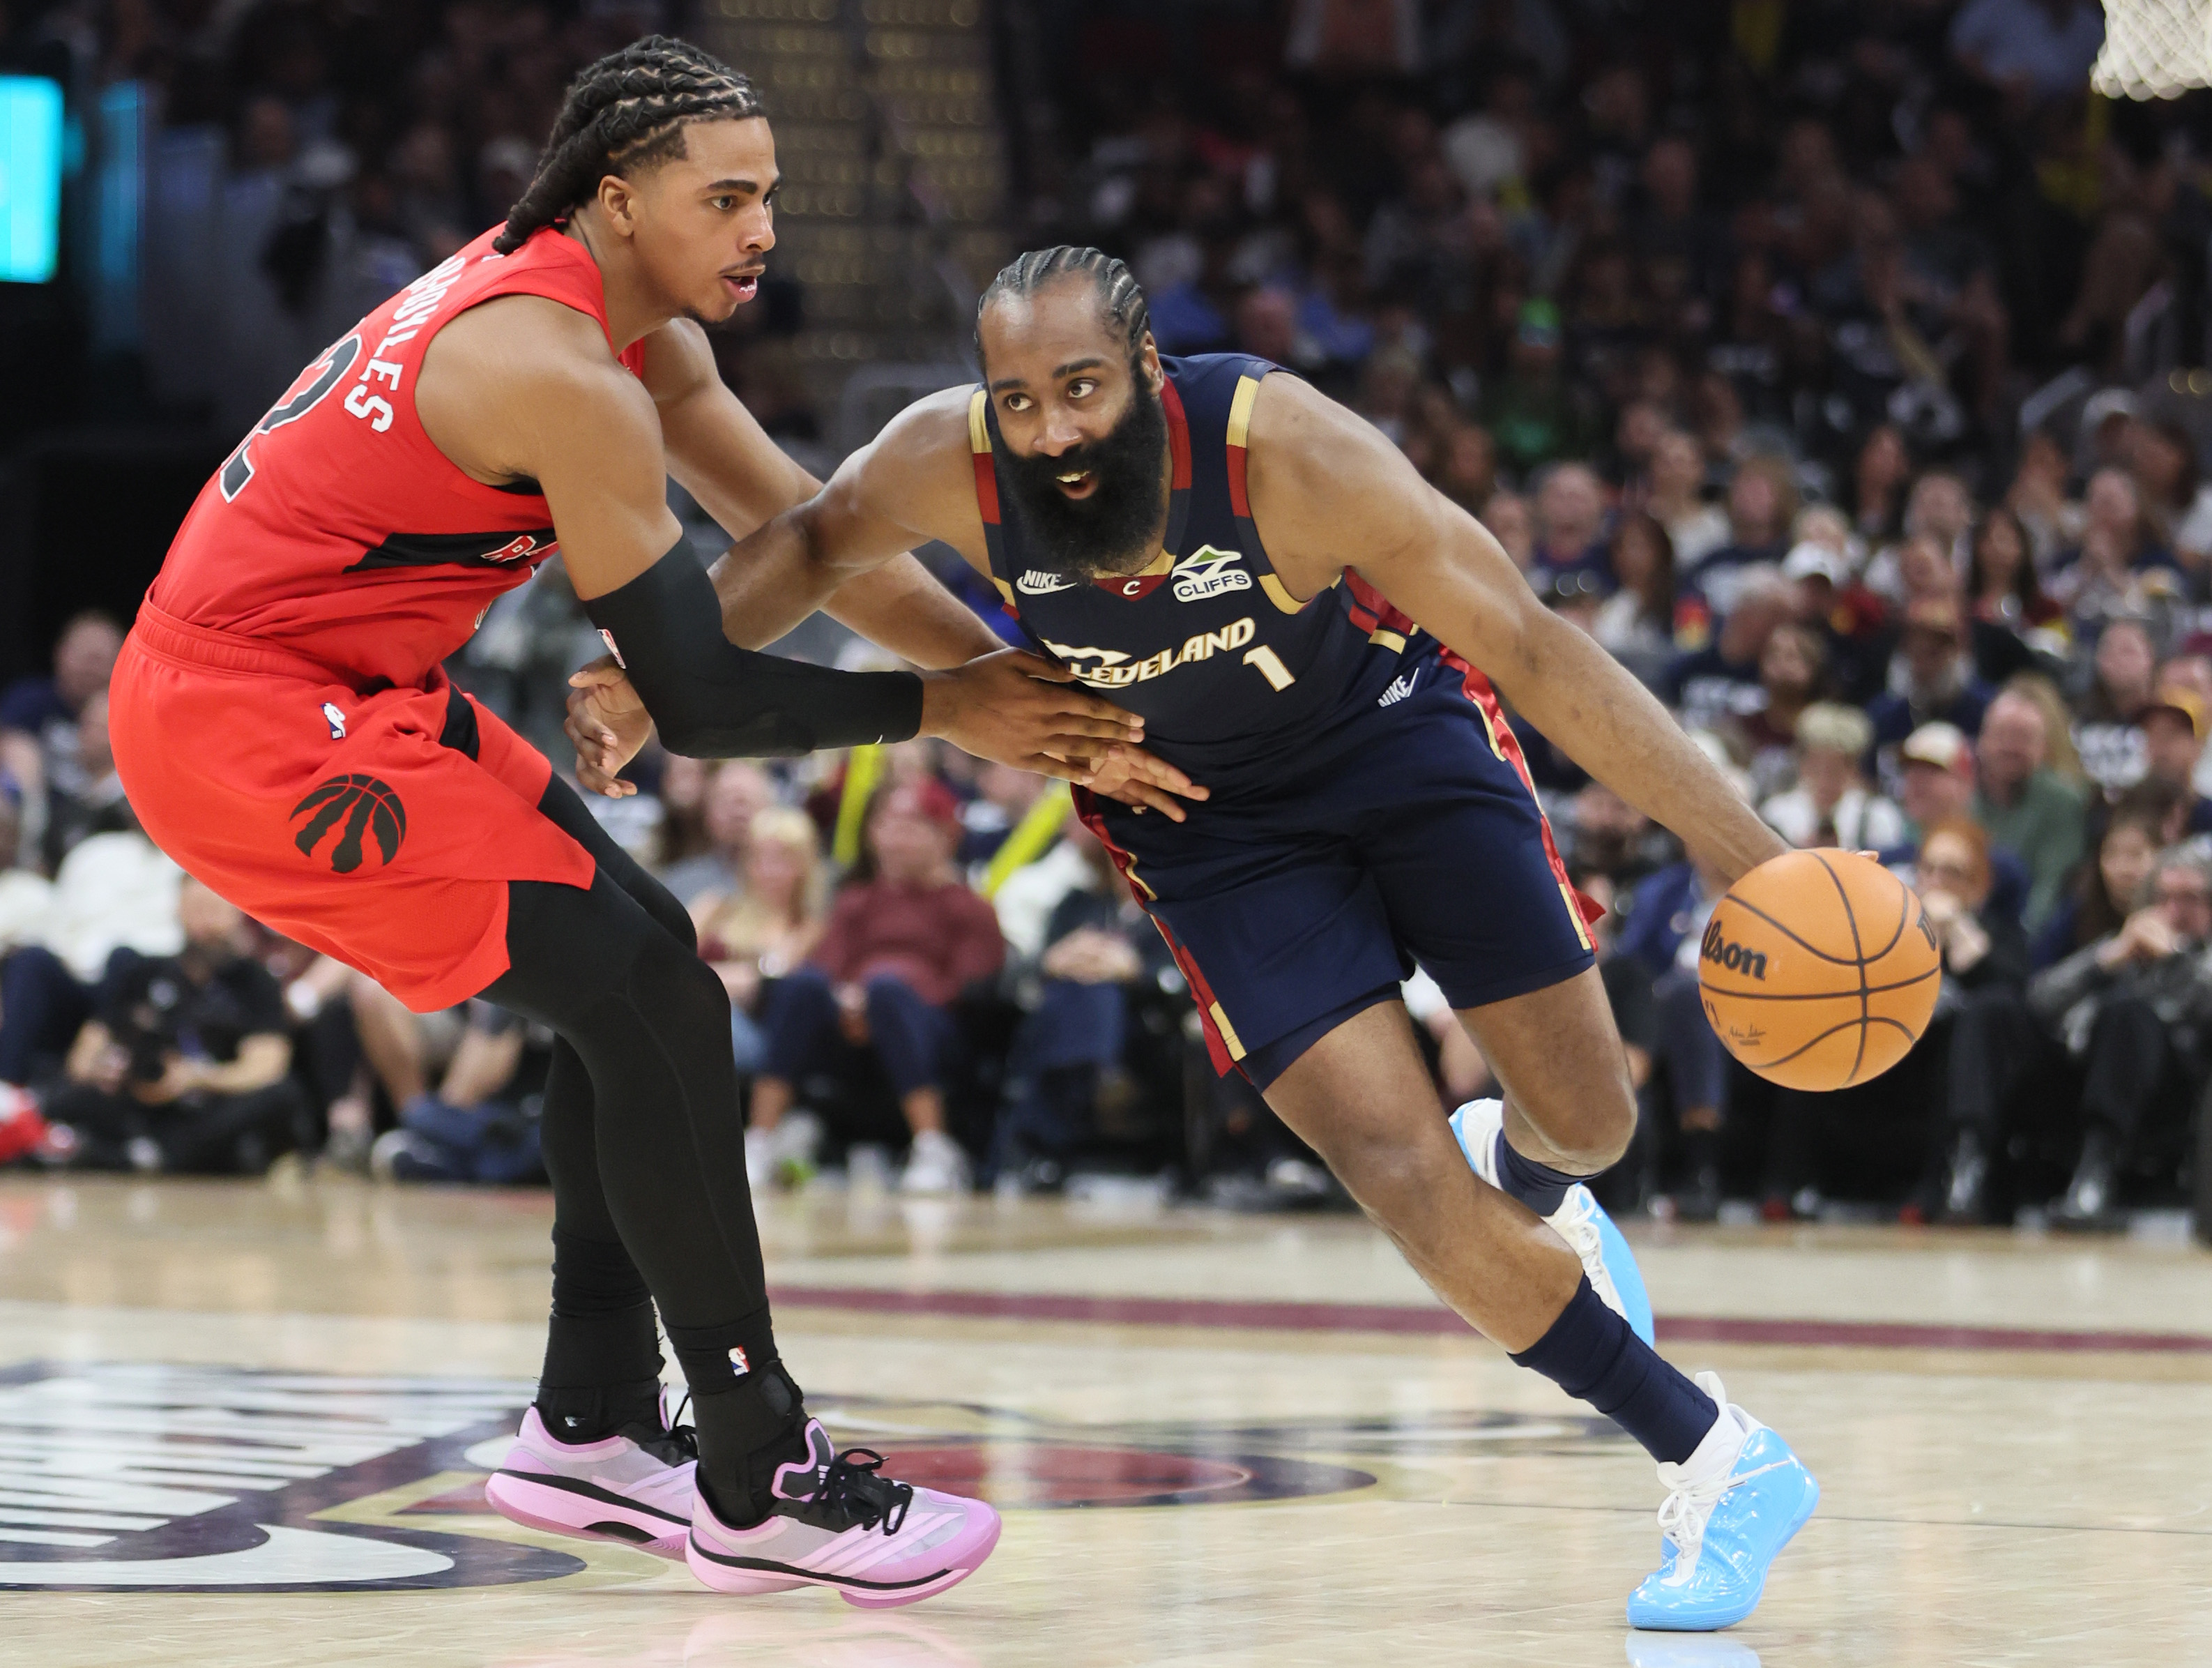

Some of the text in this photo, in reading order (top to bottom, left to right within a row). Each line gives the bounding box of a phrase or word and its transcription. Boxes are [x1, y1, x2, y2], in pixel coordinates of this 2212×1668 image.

[220, 334, 362, 503] 2
[1023, 569, 1062, 588] NIKE
[1122, 580, 1141, 596] C
[1177, 574, 1249, 597] CLIFFS
[1243, 644, 1295, 692] 1
[1378, 675, 1410, 707] NIKE
[1702, 920, 1767, 981] lson
